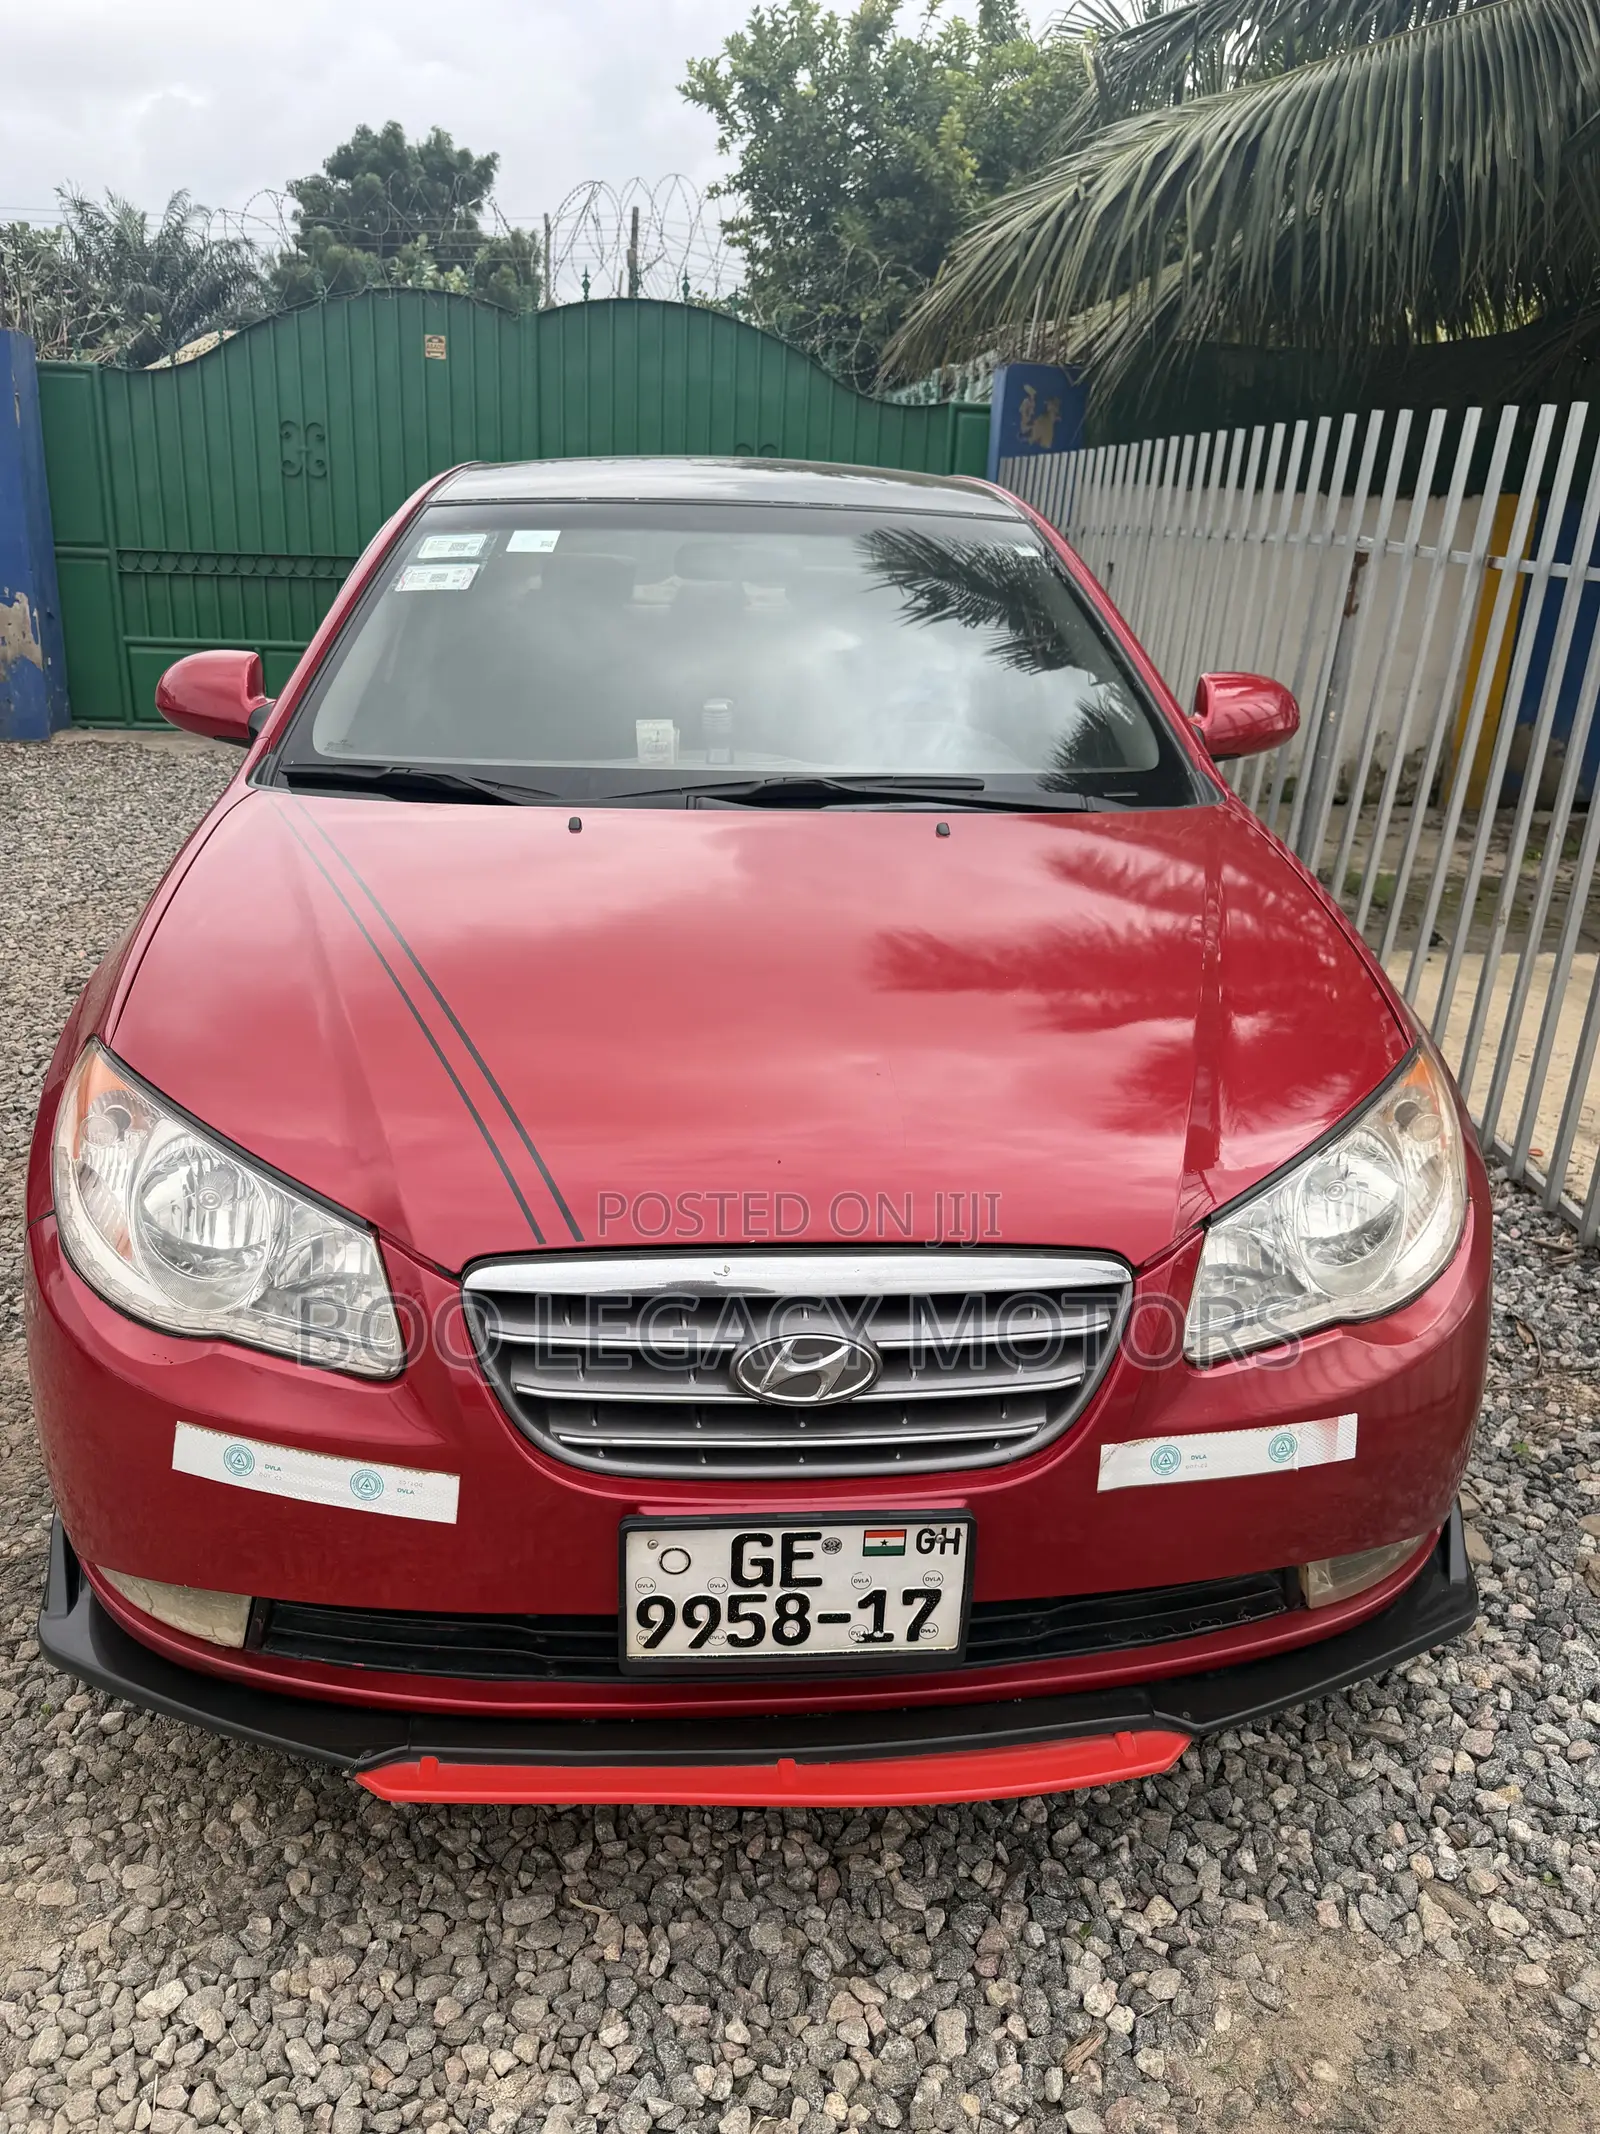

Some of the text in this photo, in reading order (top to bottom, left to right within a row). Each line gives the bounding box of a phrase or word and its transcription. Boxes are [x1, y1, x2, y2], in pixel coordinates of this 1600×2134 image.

[264, 1463, 282, 1472] DVLA
[396, 1487, 415, 1496] DVLA
[915, 1527, 961, 1556] GH
[730, 1532, 822, 1588] GE
[636, 1588, 942, 1649] 9958-17
